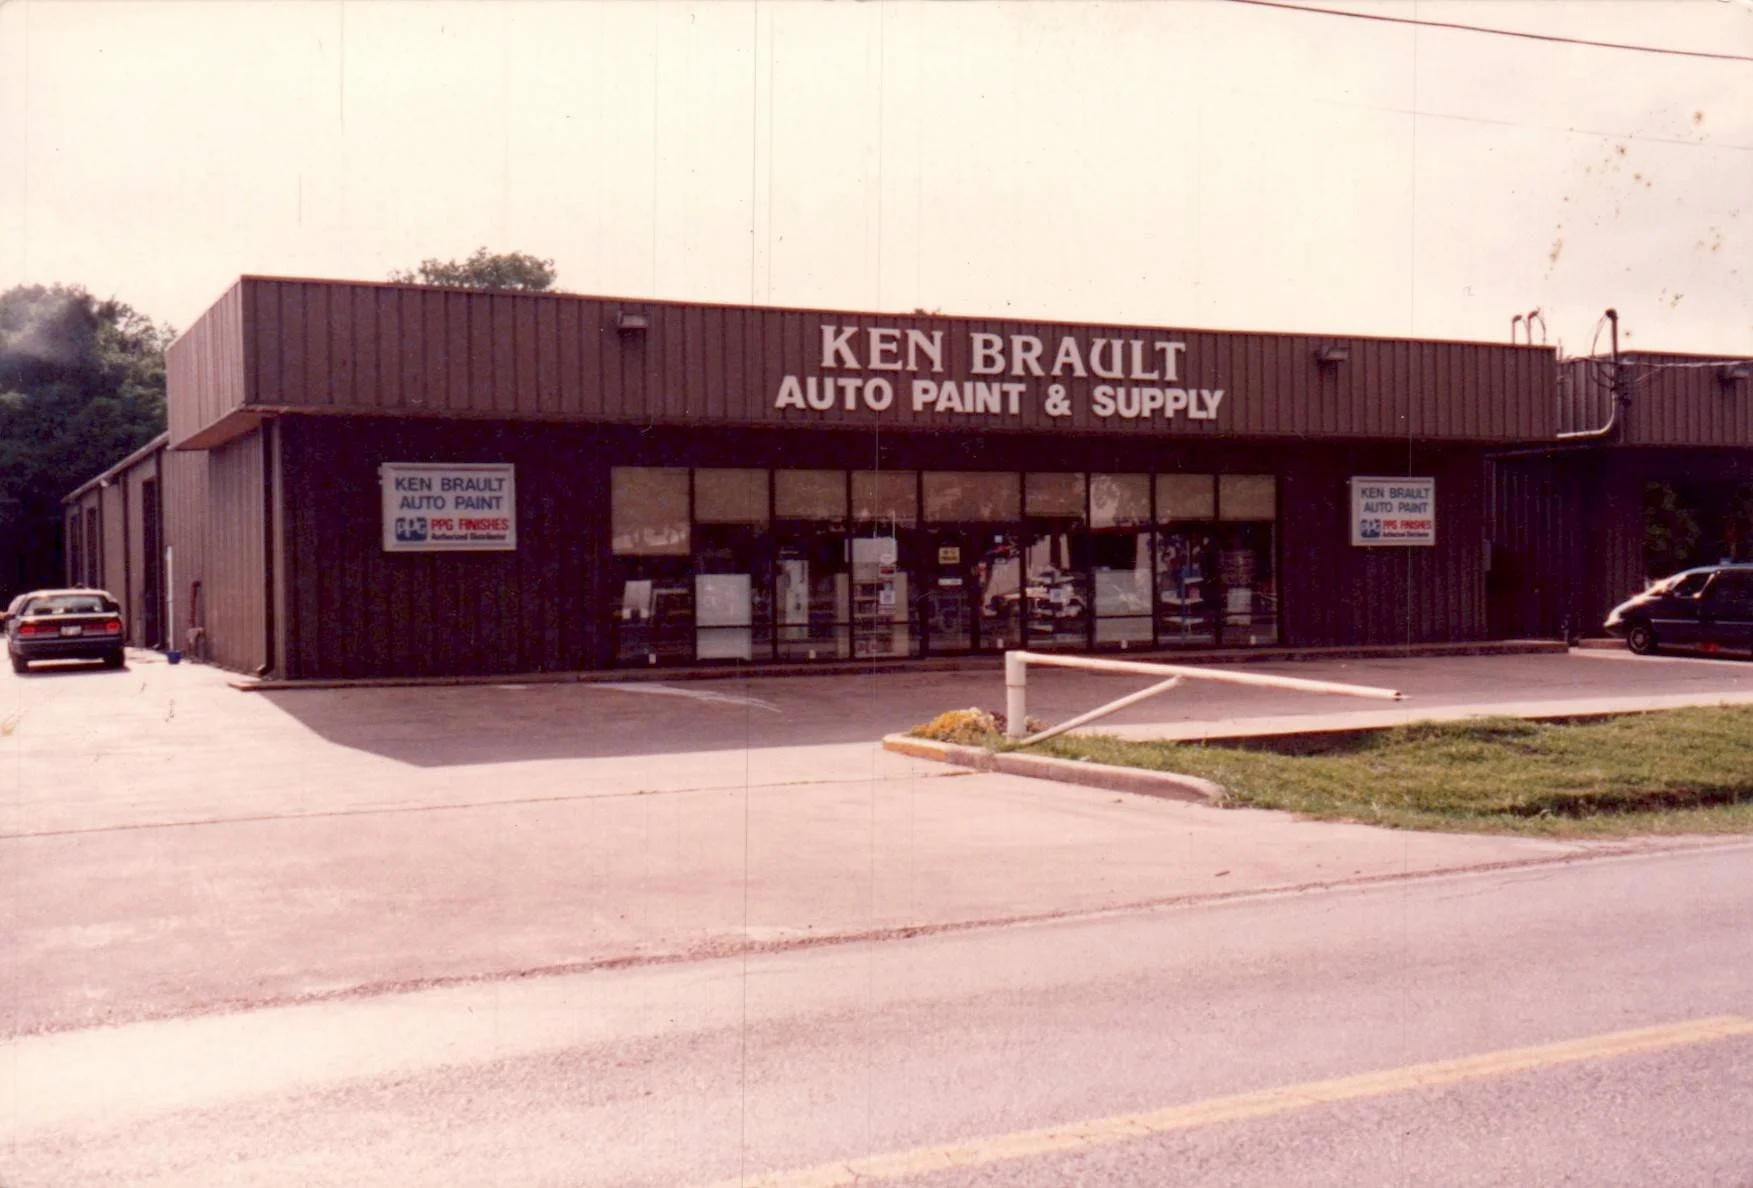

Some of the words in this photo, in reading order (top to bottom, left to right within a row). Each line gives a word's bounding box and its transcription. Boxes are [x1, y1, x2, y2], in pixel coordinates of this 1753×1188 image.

[820, 324, 944, 374] KEN
[969, 332, 1187, 382] BRAULT
[775, 374, 894, 411] AUTO
[912, 379, 1026, 415] PAINT
[1044, 383, 1072, 416] &
[1092, 384, 1225, 419] SUPPLY
[395, 477, 432, 491] KEN
[441, 478, 505, 492] BRAULT
[1361, 487, 1385, 499] KEN
[1389, 487, 1430, 499] BRAULT
[399, 495, 446, 510] AUTO
[454, 496, 503, 510] PAINT
[1363, 501, 1393, 513] AUTO
[1398, 502, 1428, 513] PAINT
[431, 518, 454, 531] PPG
[458, 518, 509, 531] FINISHES
